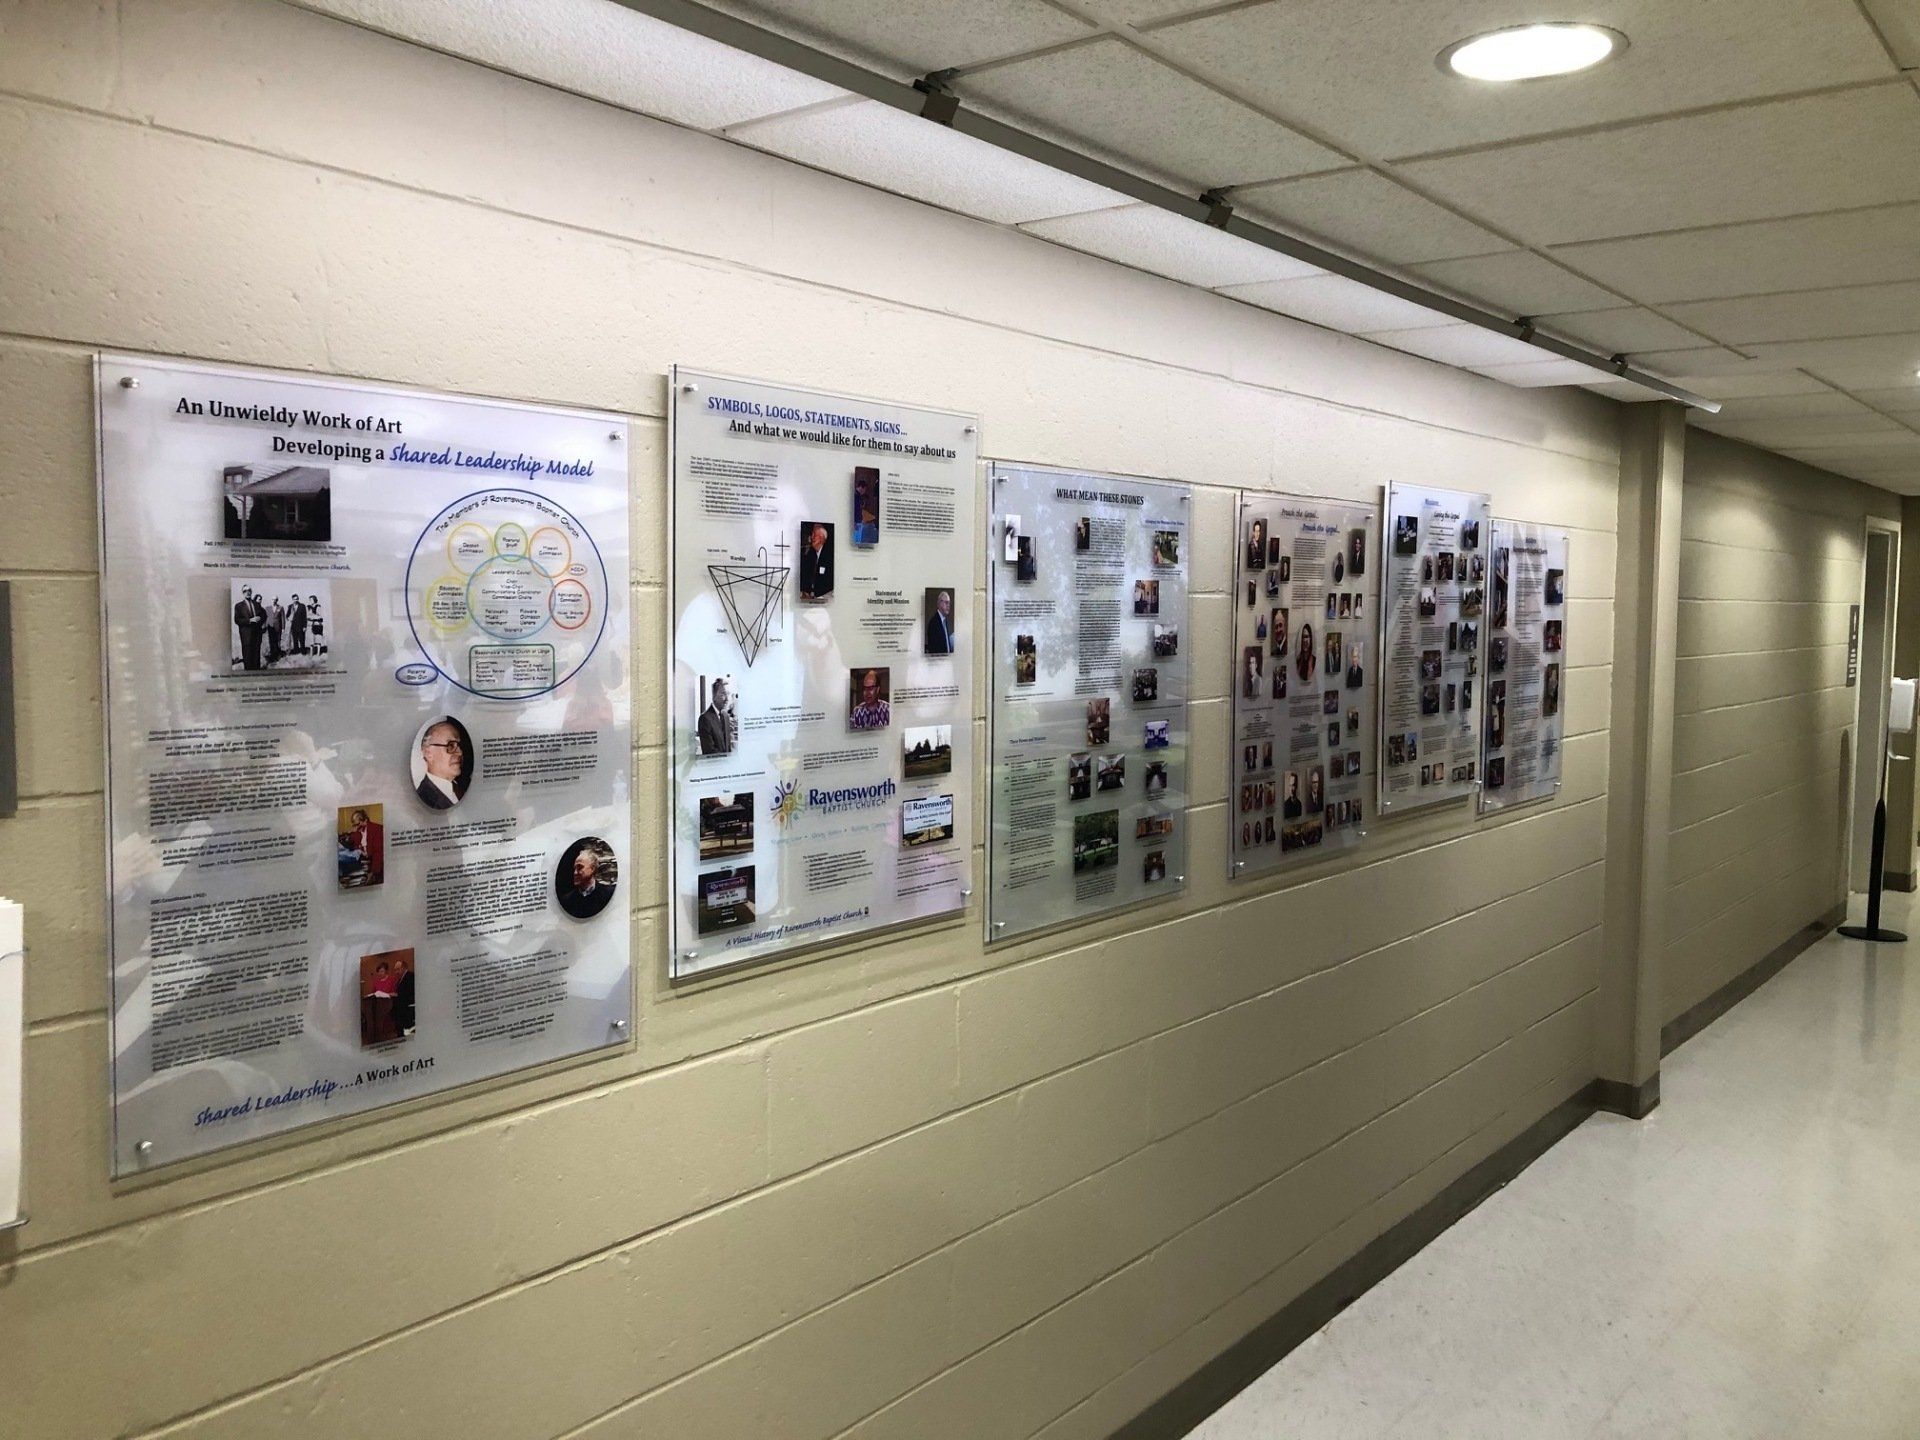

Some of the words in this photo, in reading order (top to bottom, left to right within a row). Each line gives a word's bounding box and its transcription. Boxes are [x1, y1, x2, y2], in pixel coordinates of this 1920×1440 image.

[176, 397, 203, 416] An
[209, 400, 299, 428] Unwieldy
[303, 409, 352, 429] Work
[356, 411, 373, 431] of
[376, 416, 403, 434] Art
[707, 396, 763, 420] SYMBOLS,
[765, 405, 803, 423] LOGOS,
[805, 411, 873, 432] STATEMENTS,
[273, 436, 371, 463] Developing
[375, 447, 385, 460] a
[390, 443, 451, 467] Shared
[455, 451, 543, 479] Leadership
[546, 457, 595, 479] Model
[729, 420, 751, 434] And
[754, 423, 781, 438] what
[783, 428, 797, 439] we
[800, 429, 830, 443] would
[832, 432, 850, 446] like
[852, 434, 866, 448] for
[868, 437, 891, 450] them
[893, 441, 902, 452] to
[904, 442, 918, 456] say
[920, 443, 944, 457] about
[946, 448, 956, 459] us
[1056, 488, 1077, 500] WHAT
[1078, 491, 1098, 503] MEAN
[1099, 492, 1120, 504] THESE
[1120, 494, 1144, 506] STONES
[809, 778, 896, 804] Ravensworth
[822, 803, 853, 815] BAPTIST
[855, 798, 888, 810] CHURCH
[725, 939, 732, 947] A
[733, 933, 753, 945] Visual
[754, 929, 776, 940] History
[777, 926, 785, 939] of
[823, 914, 842, 927] Baptist
[843, 908, 863, 920] Church
[194, 1097, 252, 1126] Shared
[255, 1079, 338, 1109] Leadership
[366, 1065, 400, 1082] Work
[402, 1058, 415, 1073] of
[415, 1057, 435, 1071] Art
